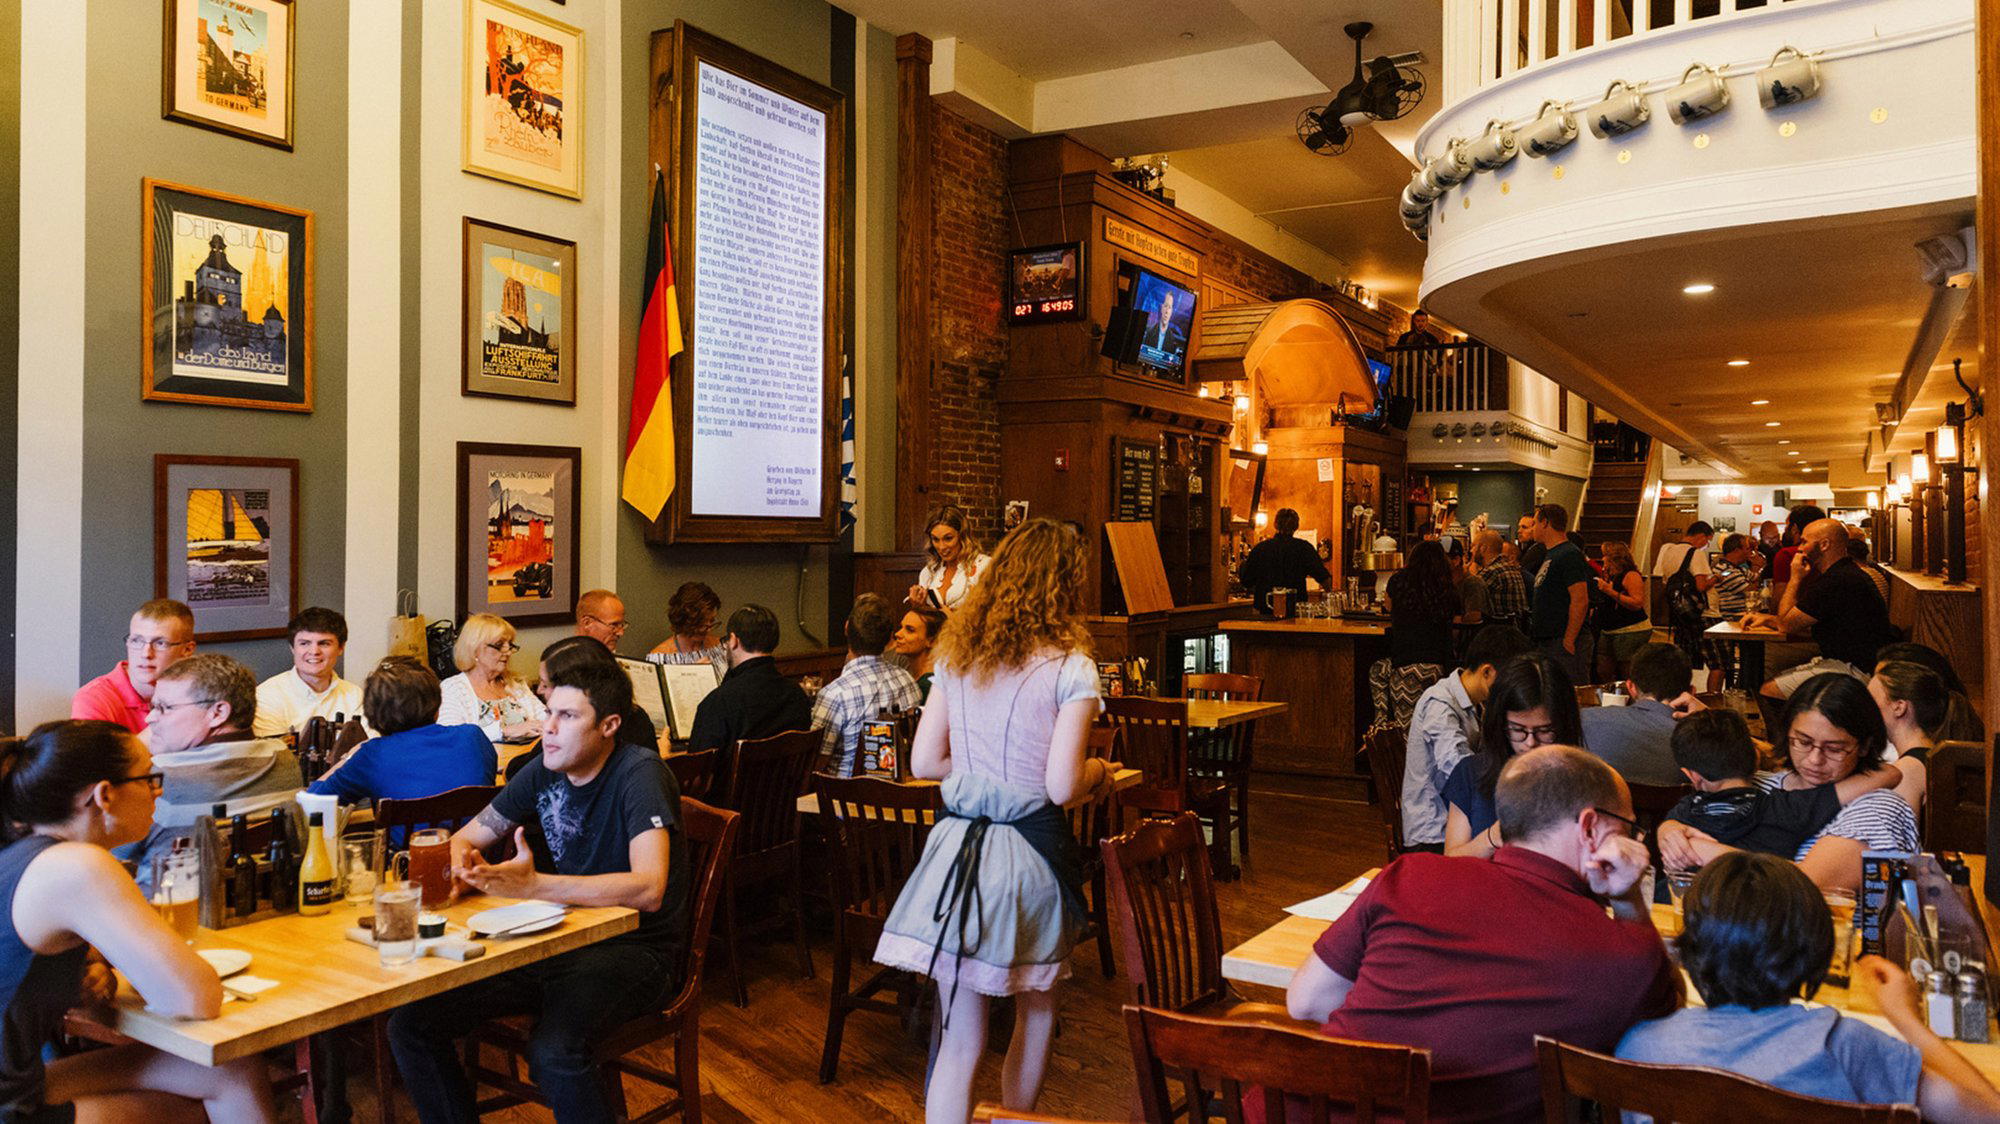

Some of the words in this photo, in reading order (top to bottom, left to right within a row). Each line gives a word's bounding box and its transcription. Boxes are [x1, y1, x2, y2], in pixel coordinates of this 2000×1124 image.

[228, 2, 253, 15] TWA
[205, 94, 213, 104] TO
[216, 97, 249, 112] GERMANY
[176, 214, 285, 254] DEUTSCHLAND
[218, 345, 241, 359] das
[242, 346, 271, 361] Land
[485, 345, 557, 364] LUFTSCHIFFAHRT
[490, 355, 553, 371] AUSSTELLUNG
[495, 367, 543, 380] FRANKFURT
[490, 471, 519, 479] MOTORING
[526, 472, 552, 480] GERMANY
